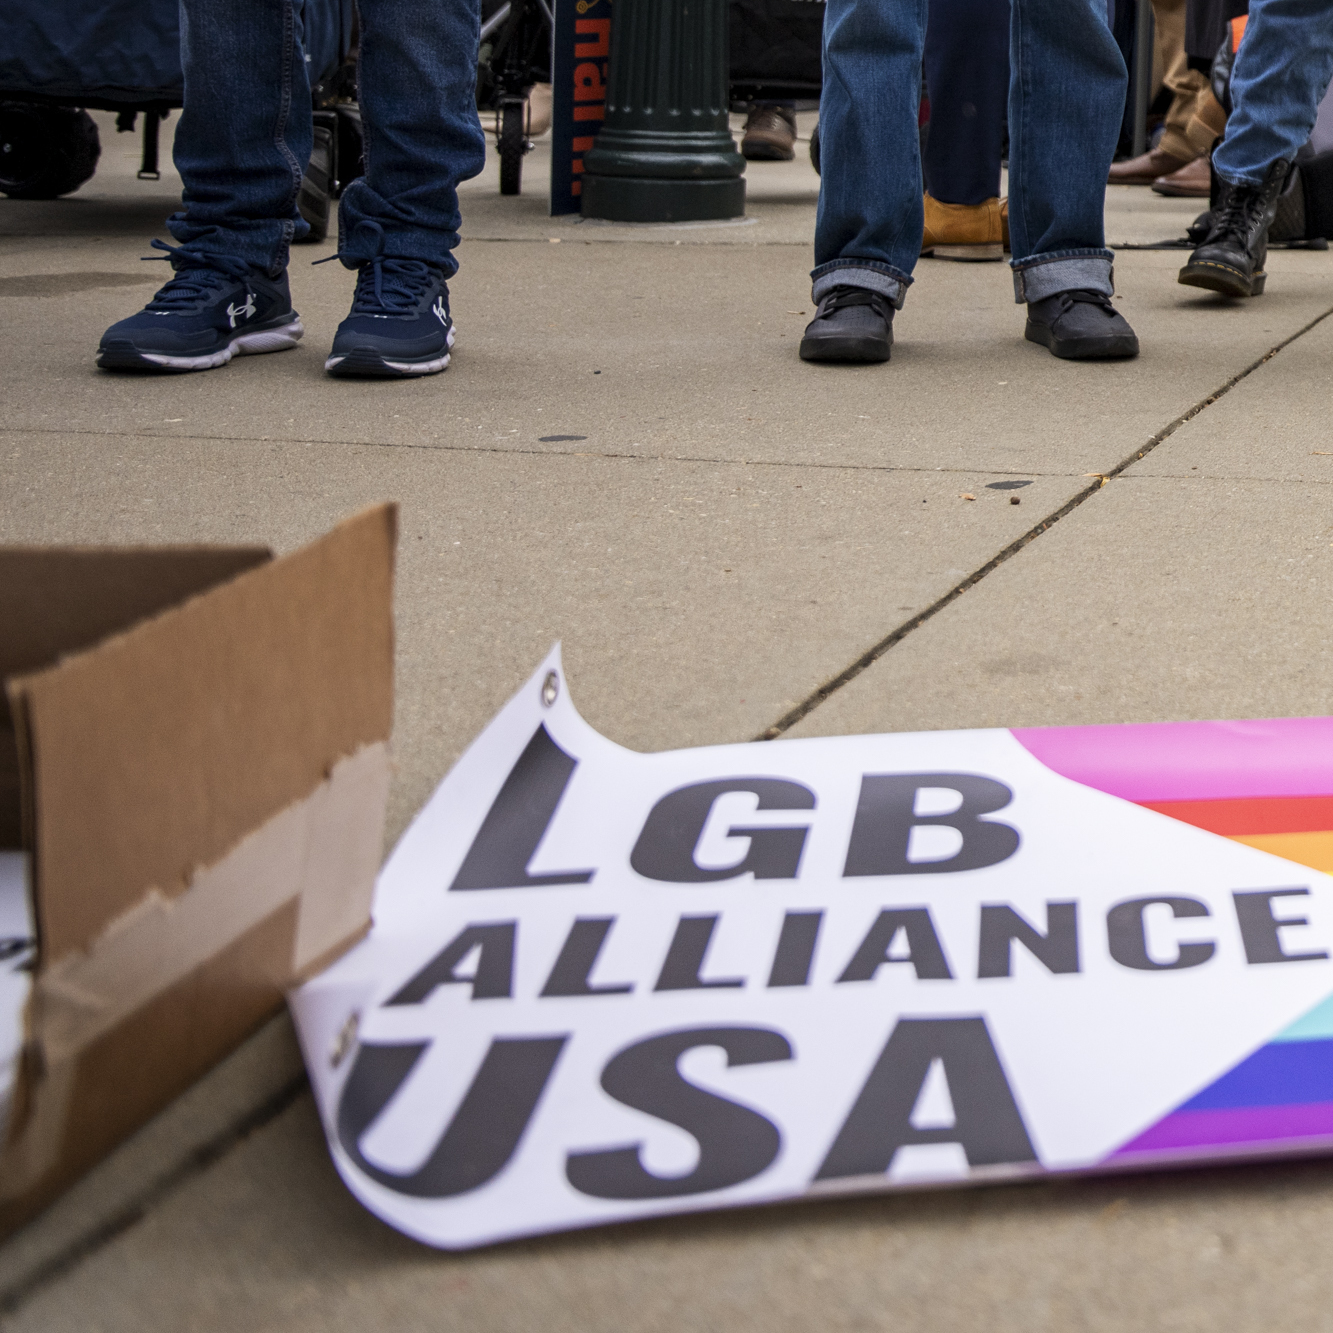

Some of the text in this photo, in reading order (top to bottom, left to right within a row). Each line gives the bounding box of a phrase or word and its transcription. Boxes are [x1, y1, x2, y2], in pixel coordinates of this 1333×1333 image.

[449, 721, 1021, 892] LGB
[378, 886, 1331, 1008] ALLIANCE
[336, 1013, 1047, 1199] USA
